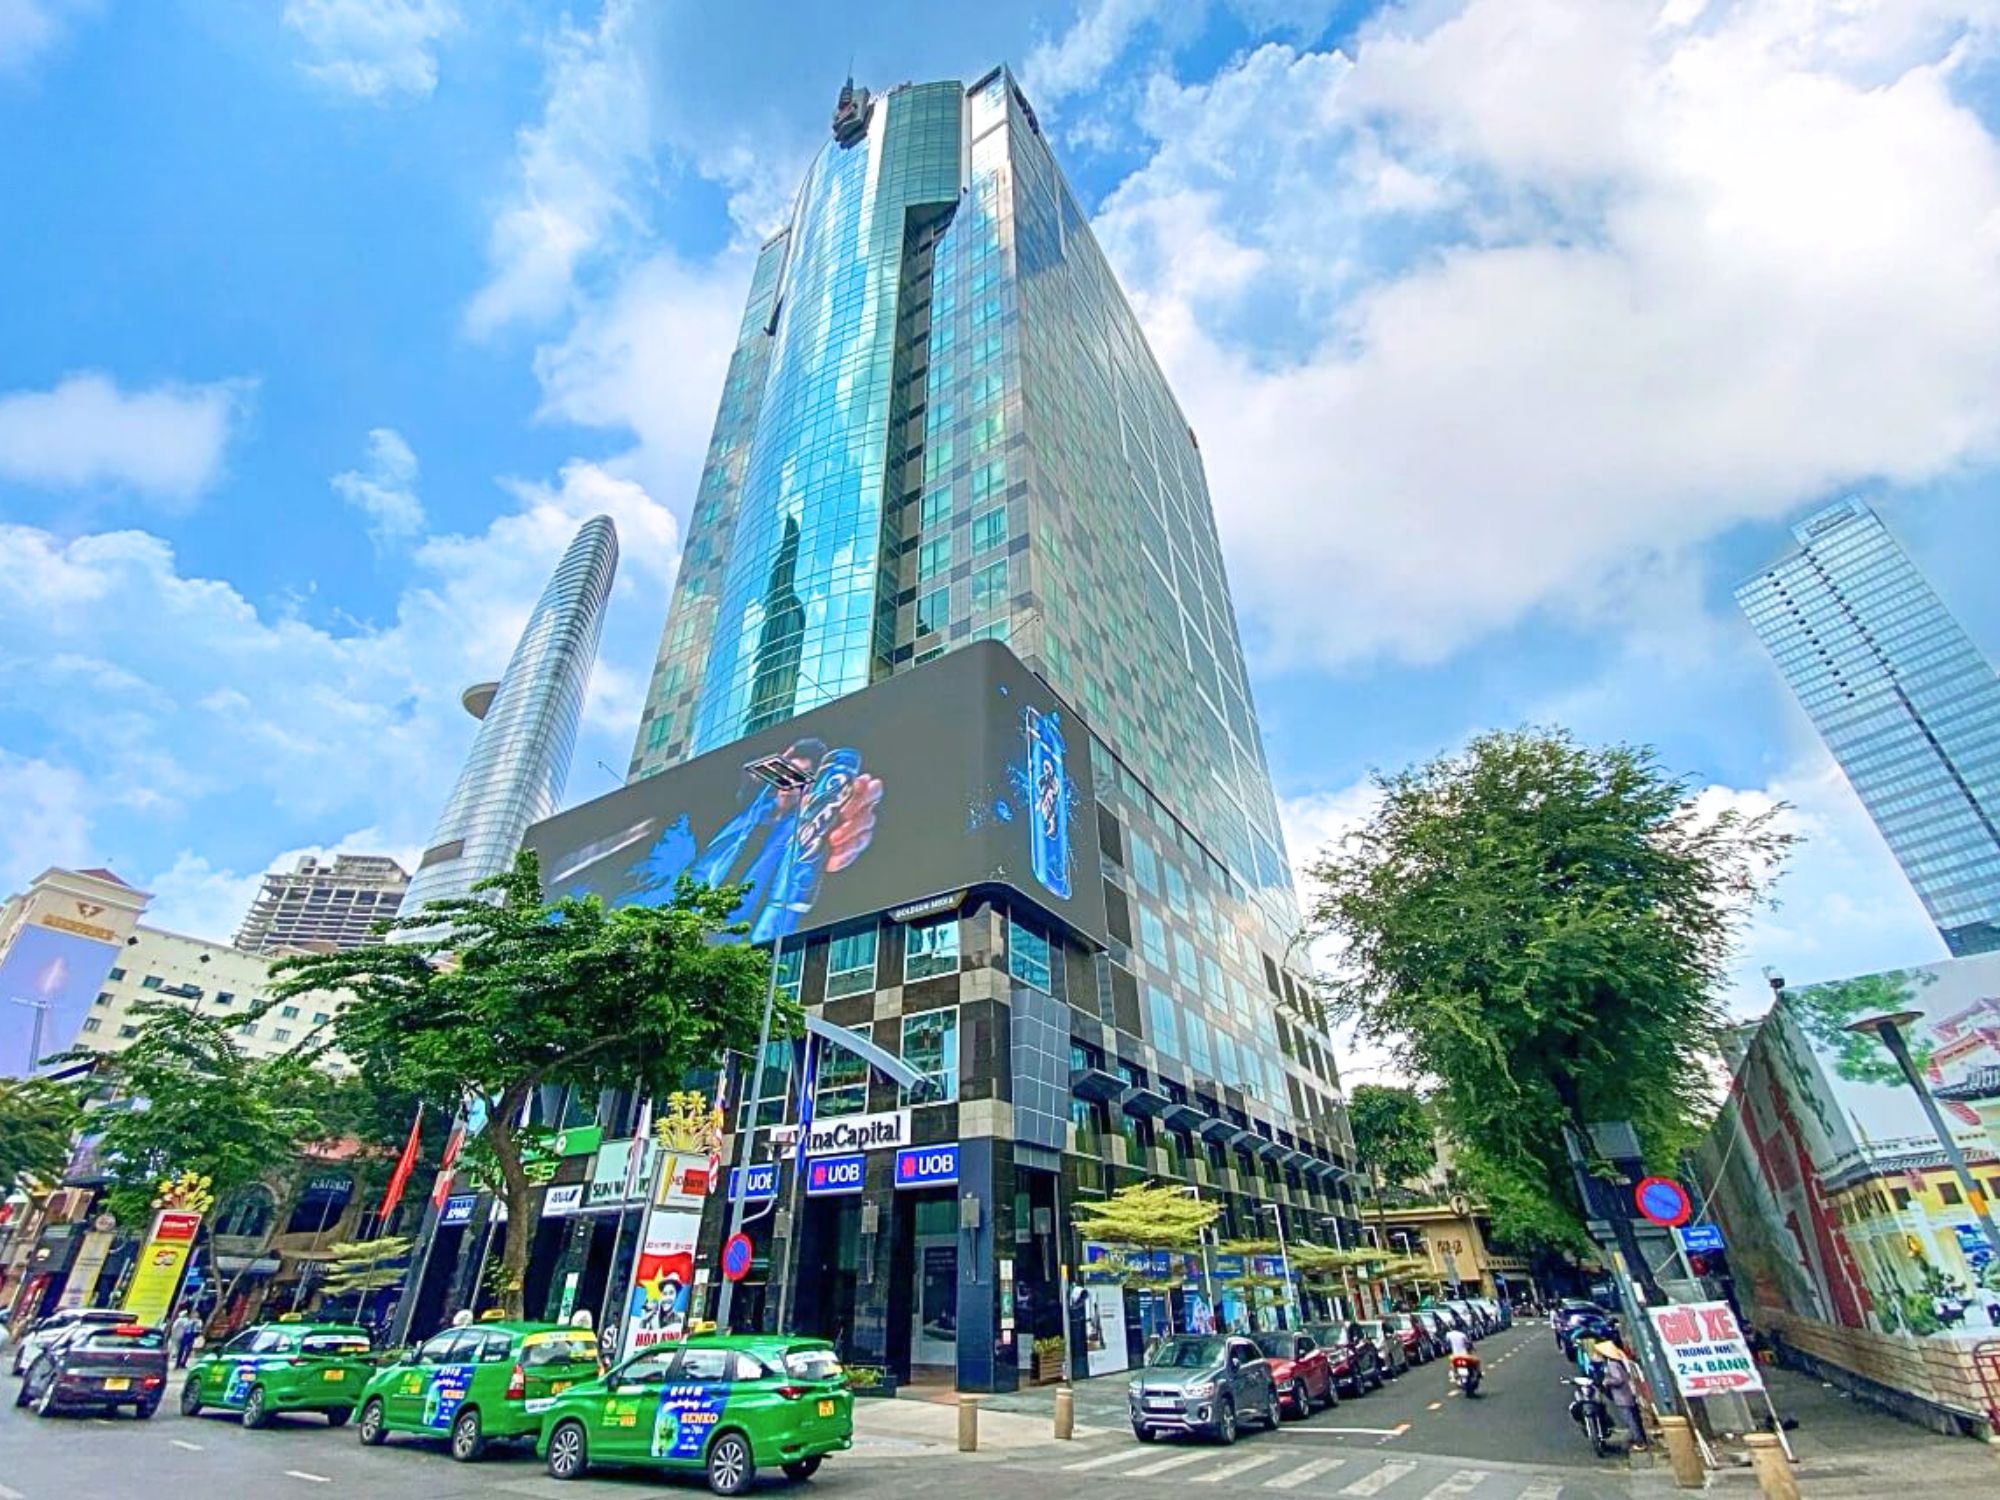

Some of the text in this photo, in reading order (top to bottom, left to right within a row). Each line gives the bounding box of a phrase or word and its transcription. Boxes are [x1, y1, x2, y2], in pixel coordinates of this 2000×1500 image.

[794, 1115, 901, 1152] inaCapital
[828, 1164, 860, 1183] UOB
[919, 1154, 953, 1175] UOB
[1698, 1307, 1740, 1341] XE
[1675, 1345, 1712, 1358] TRONG
[1677, 1361, 1703, 1375] 2-4
